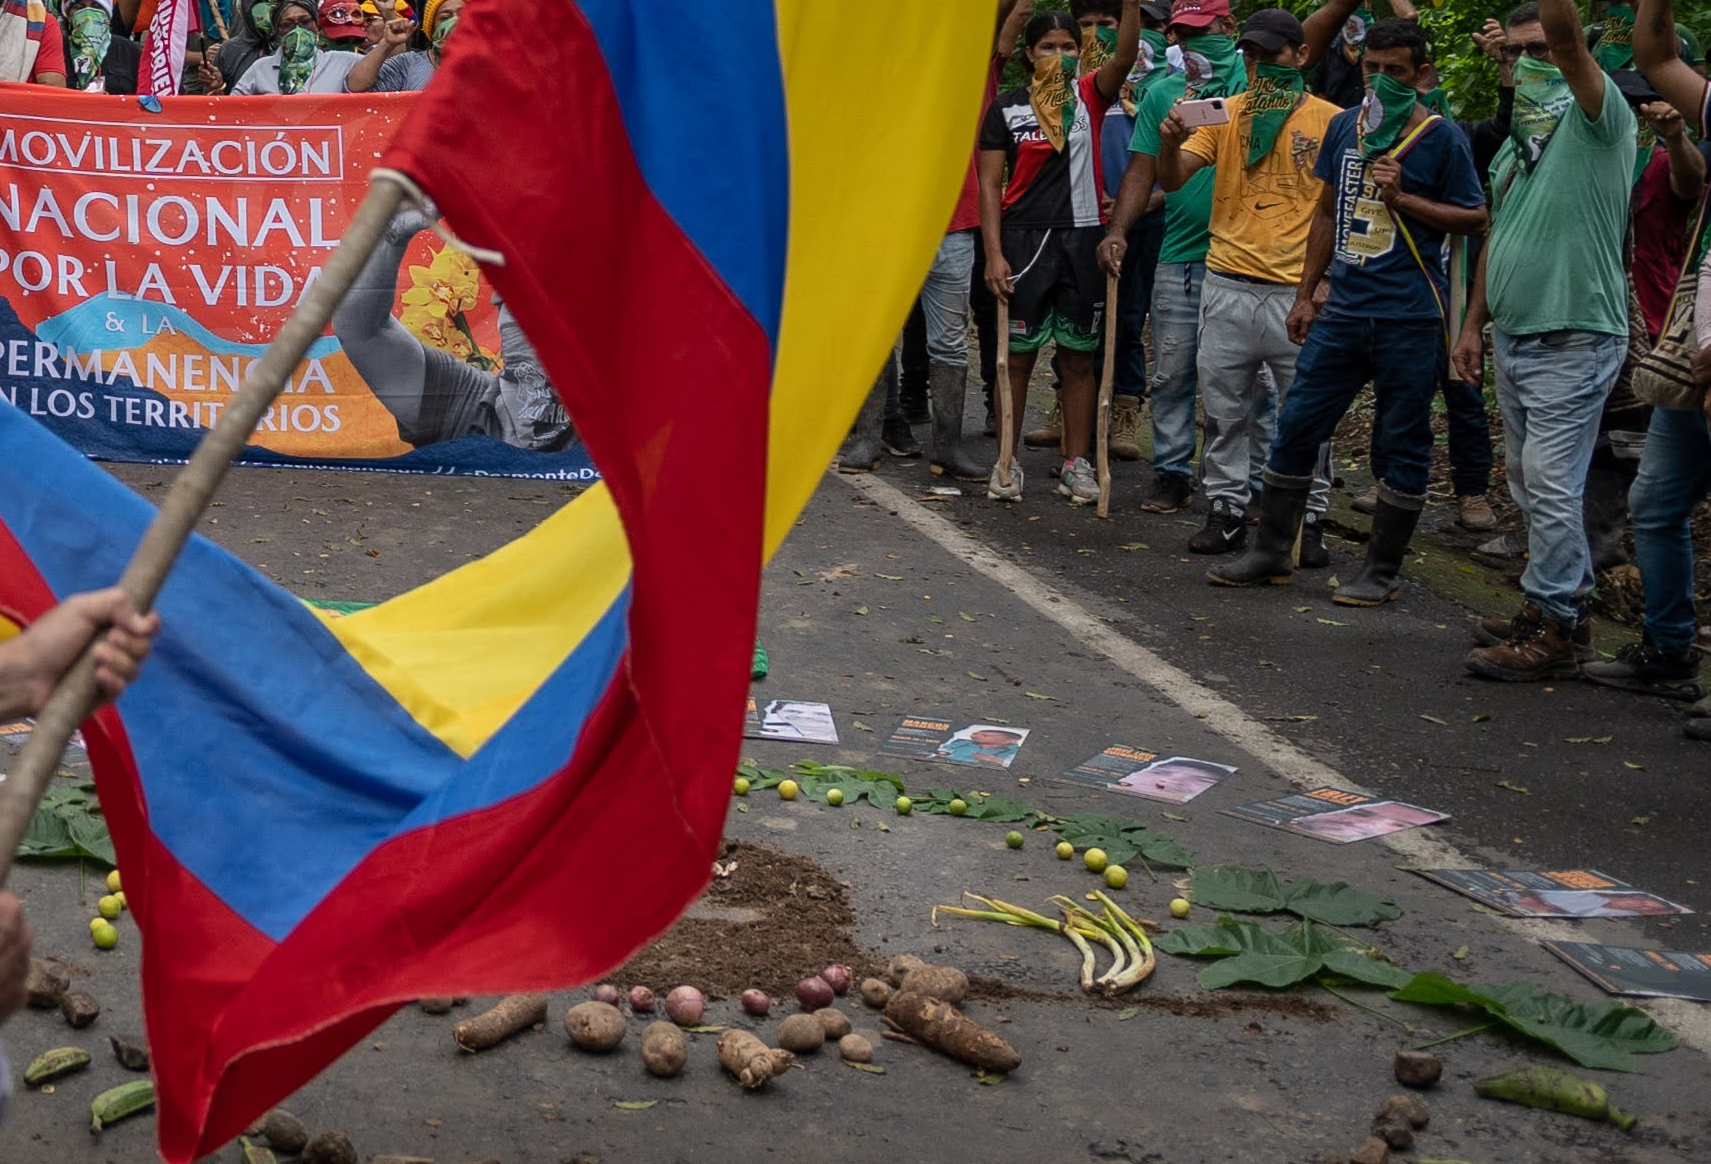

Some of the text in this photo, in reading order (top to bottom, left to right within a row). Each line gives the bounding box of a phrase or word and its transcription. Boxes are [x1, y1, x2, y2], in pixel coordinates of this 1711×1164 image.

[1360, 206, 1384, 217] GIVE
[107, 259, 178, 305] LA
[188, 263, 325, 309] VIDA
[104, 311, 178, 336] & LA
[29, 386, 97, 421] LOS
[103, 394, 343, 434] TERRITRIOS
